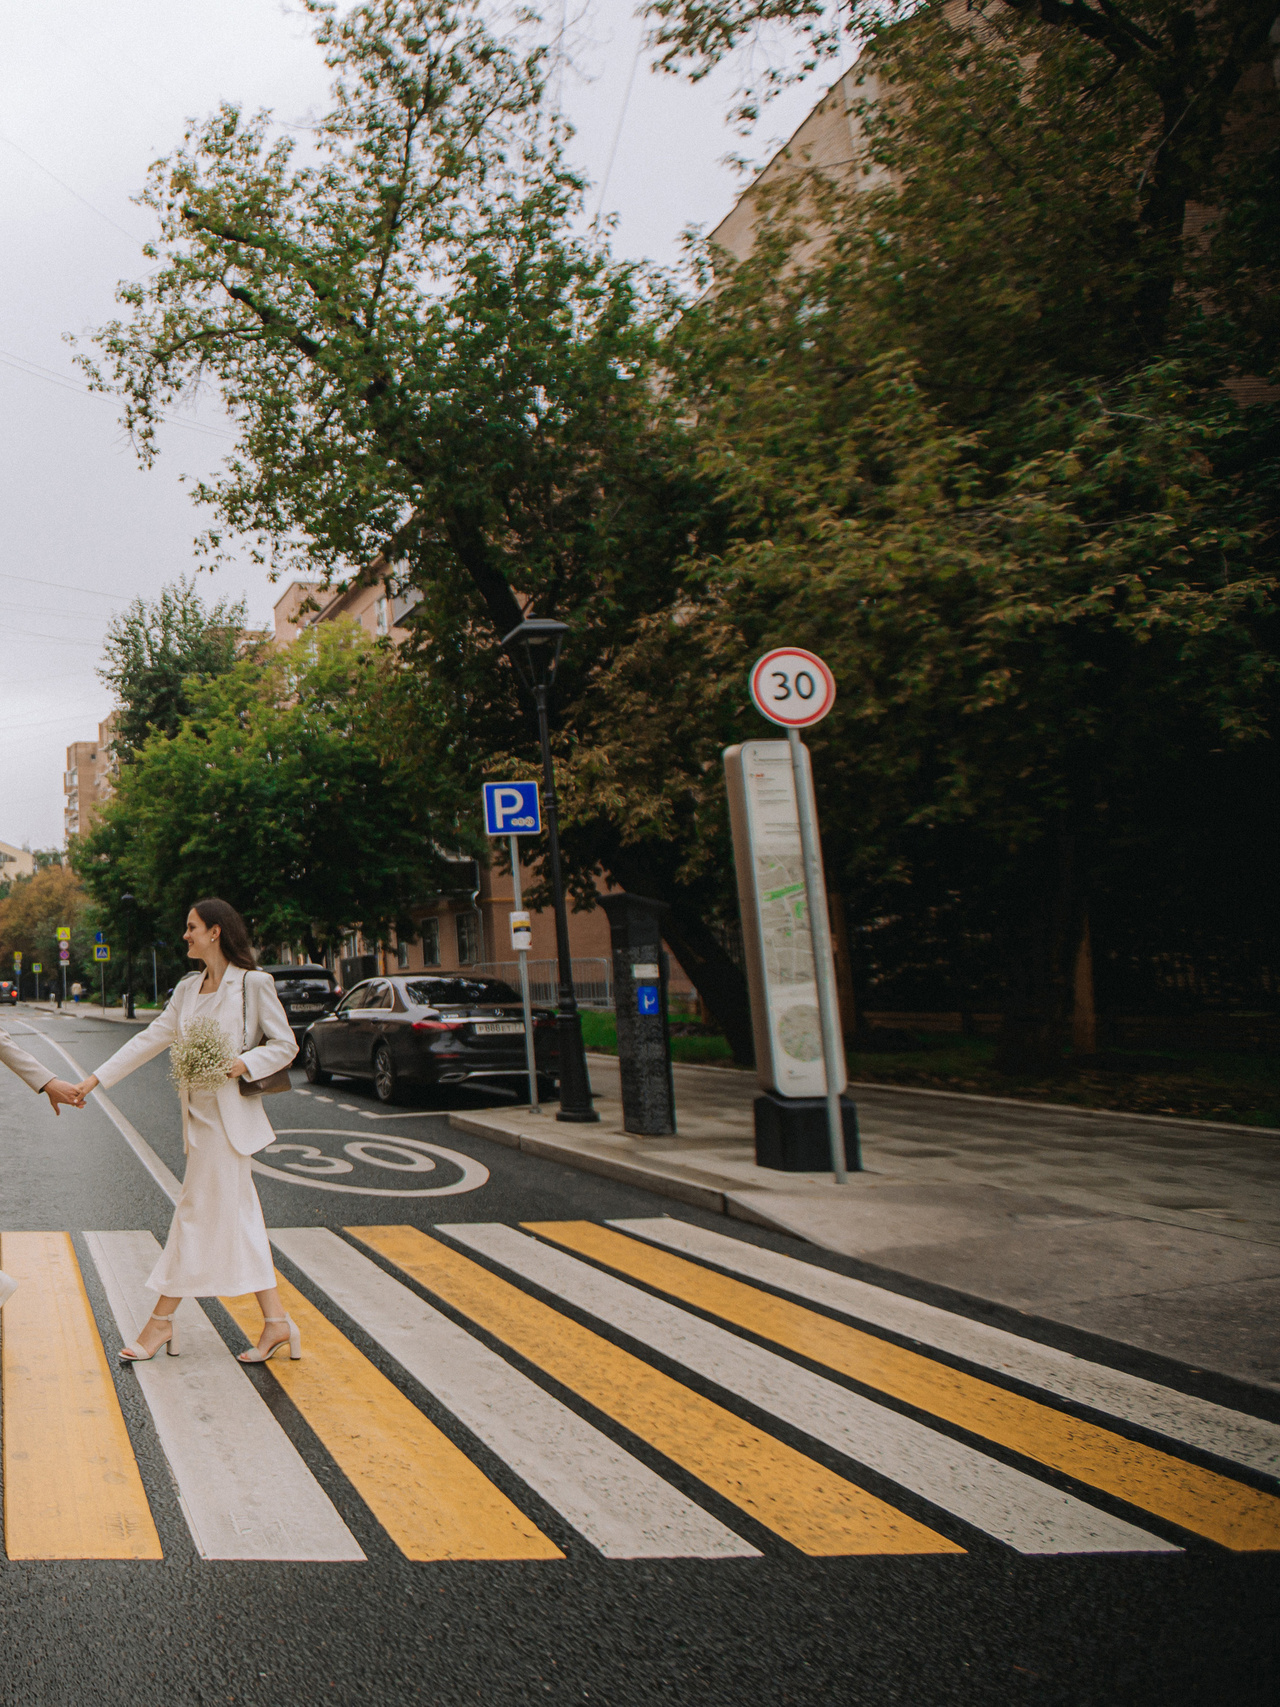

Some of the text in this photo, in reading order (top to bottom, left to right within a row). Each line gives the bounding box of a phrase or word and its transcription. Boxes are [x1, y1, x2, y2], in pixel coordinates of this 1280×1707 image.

[771, 671, 816, 700] 30
[494, 788, 523, 829] P
[265, 1142, 437, 1175] 30
